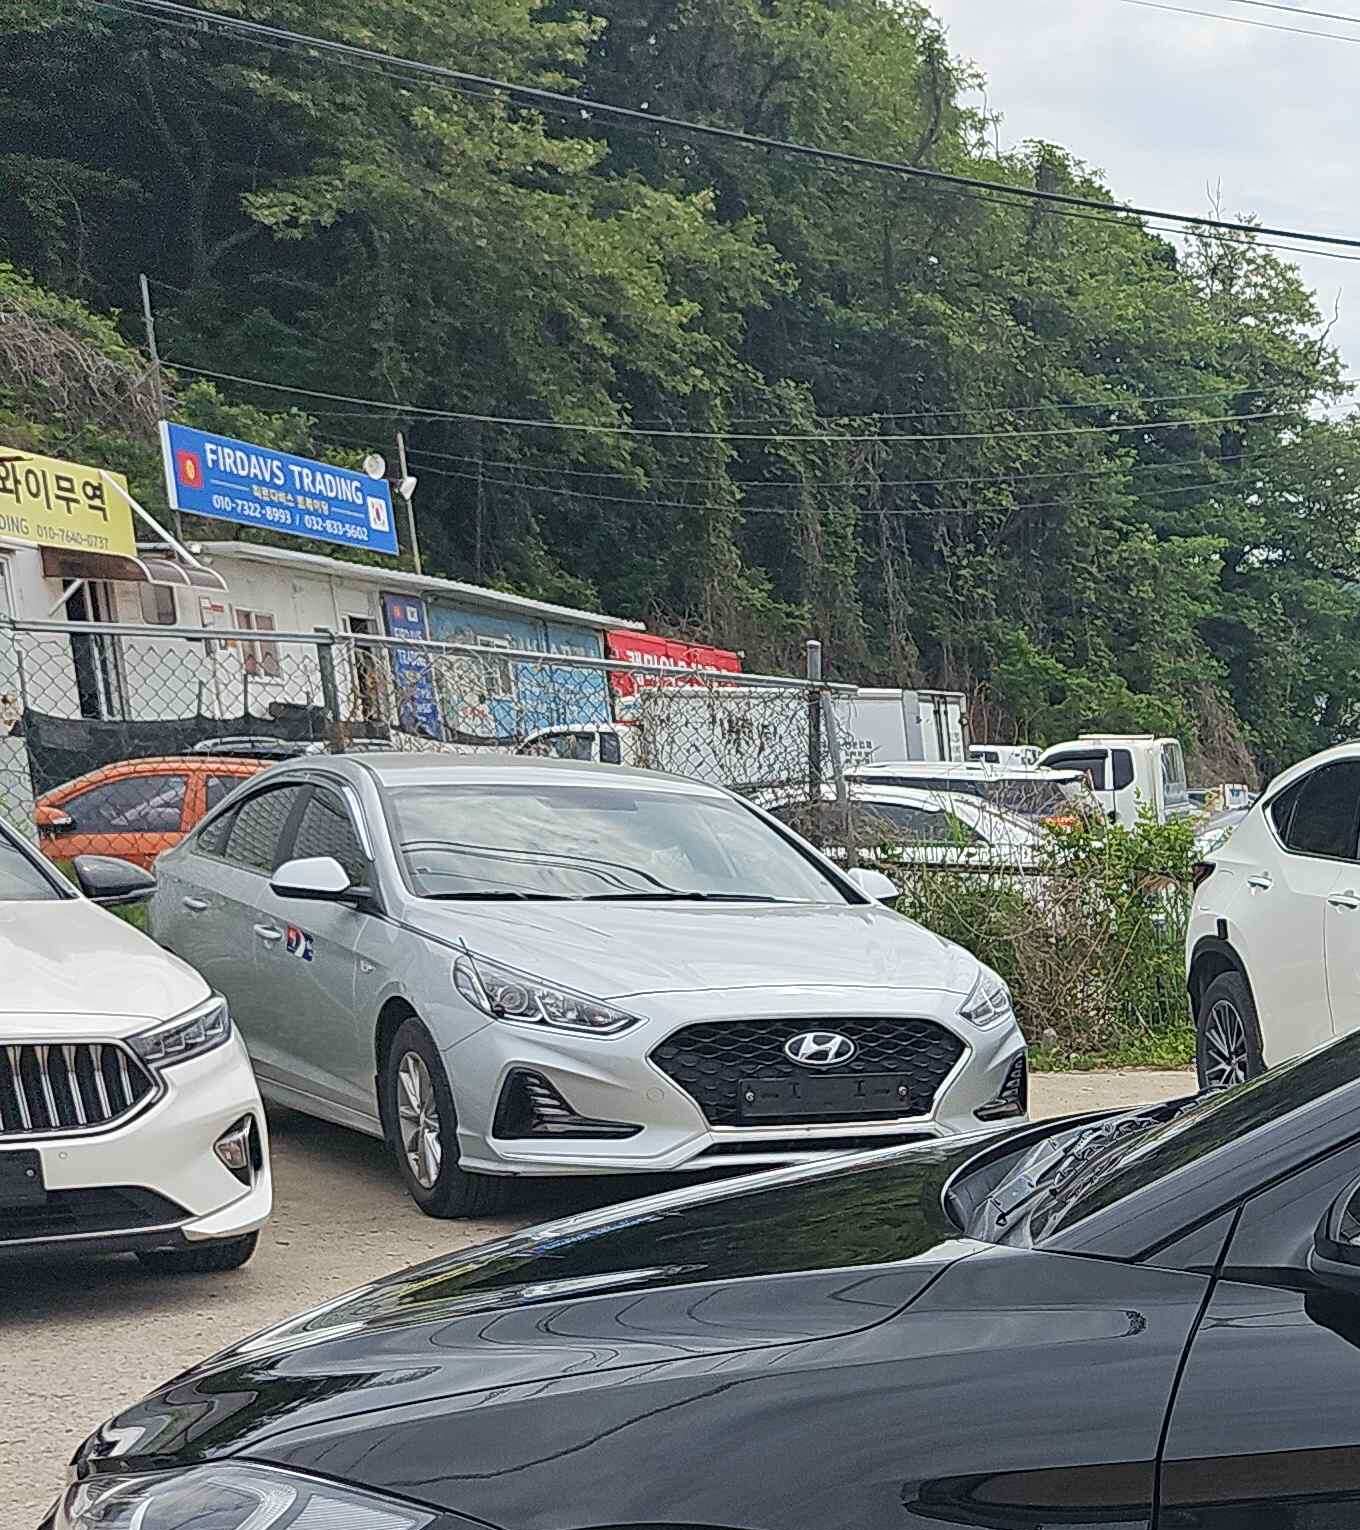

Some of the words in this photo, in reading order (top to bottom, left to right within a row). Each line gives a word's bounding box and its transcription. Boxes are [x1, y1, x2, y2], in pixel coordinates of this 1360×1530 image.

[204, 442, 285, 486] FIRDAVS
[288, 464, 364, 505] TRADING
[212, 494, 292, 525] 010-7322-8993
